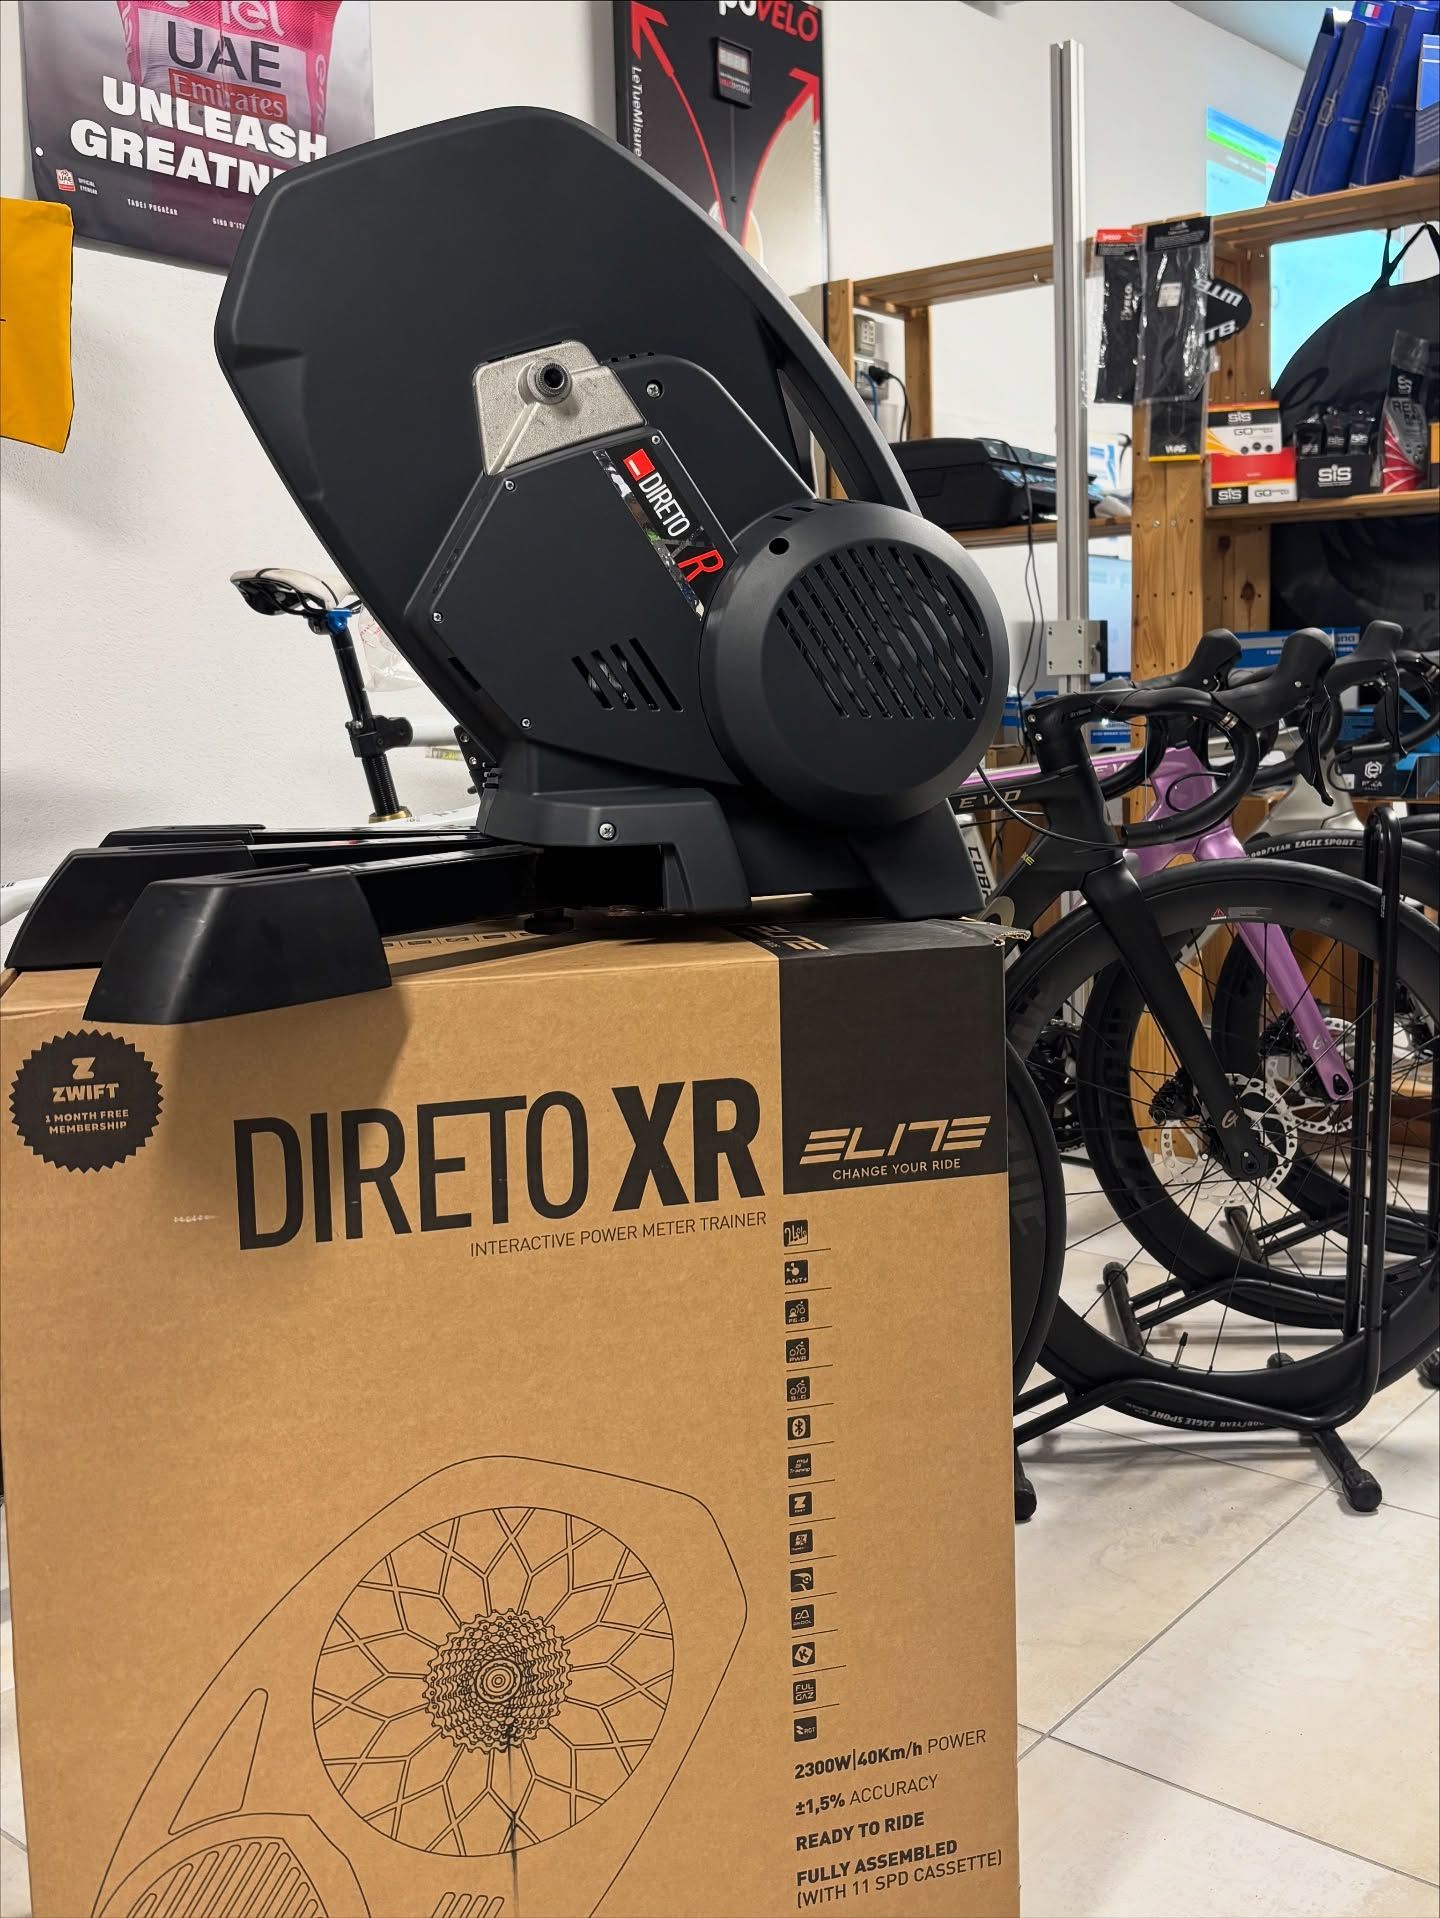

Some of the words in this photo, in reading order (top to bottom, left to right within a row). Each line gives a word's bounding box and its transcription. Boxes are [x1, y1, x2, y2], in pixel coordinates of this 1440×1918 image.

[168, 21, 281, 88] UAE
[172, 73, 284, 118] Emirates
[102, 76, 327, 164] UNLEASH
[70, 119, 287, 196] GREATN
[1198, 320, 1236, 347] TB
[1318, 464, 1352, 482] SiS
[638, 471, 691, 537] DIRETO
[959, 789, 1022, 809] EVO
[1247, 843, 1291, 858] OODYEAR
[1294, 838, 1322, 849] EAGLE
[1324, 837, 1354, 847] SPORT
[52, 1083, 120, 1103] ZWIFT
[45, 1115, 51, 1123] 1
[54, 1111, 97, 1123] MONTH
[100, 1109, 129, 1119] FREE
[49, 1121, 127, 1135] MEMBERSHIP
[799, 1115, 992, 1165] ELITE
[233, 1090, 589, 1250] DIRETO
[610, 1078, 766, 1212] XR
[832, 1165, 888, 1180] CHANGE
[892, 1161, 928, 1175] YOUR
[932, 1158, 961, 1170] RIDE
[470, 1231, 576, 1257] INTERACTIVE
[580, 1223, 638, 1245] POWER
[643, 1217, 696, 1239] METER
[700, 1211, 767, 1232] TRAINER
[928, 1729, 986, 1753] POWER
[795, 1793, 845, 1816] ±1,5%
[850, 1774, 938, 1805] ACCURACY
[796, 1825, 854, 1851] READY
[858, 1821, 880, 1837] TO
[884, 1811, 925, 1833] RIDE
[797, 1861, 850, 1886] FULLY
[854, 1840, 957, 1874] ASSEMBLED
[852, 1879, 869, 1896] 11
[875, 1872, 908, 1891] SPD
